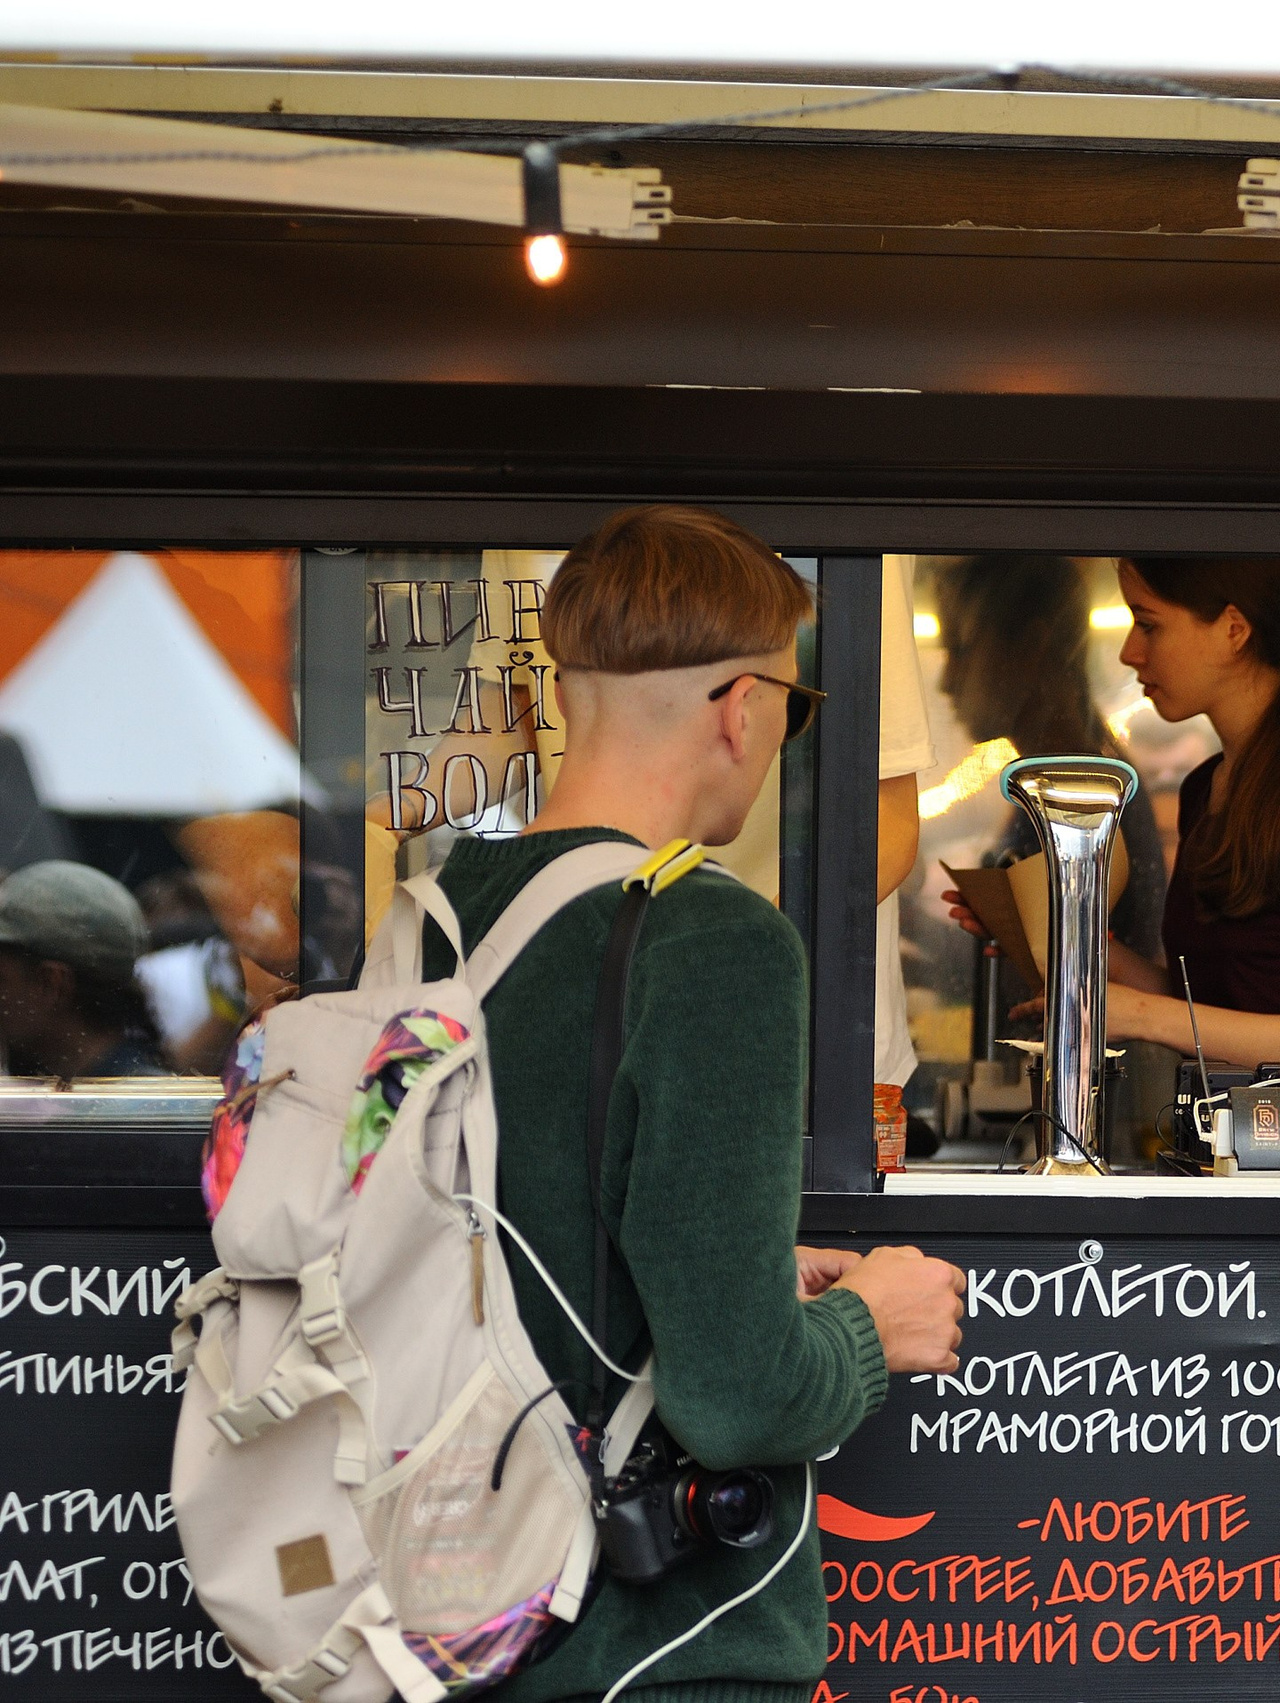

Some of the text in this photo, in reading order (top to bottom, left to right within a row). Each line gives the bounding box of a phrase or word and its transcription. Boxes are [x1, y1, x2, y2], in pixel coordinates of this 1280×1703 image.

[370, 651, 557, 738] ЧАЙ
[379, 751, 563, 840] ВОД
[968, 1261, 1266, 1320] КОТЛЕТОЙ.
[1150, 1354, 1210, 1399] ИЗ
[910, 1406, 1207, 1455] МРАМОРНОЙ
[42, 1488, 177, 1533] ГРИЛЕ
[1017, 1493, 1250, 1544] -ЛЮБИТЕ
